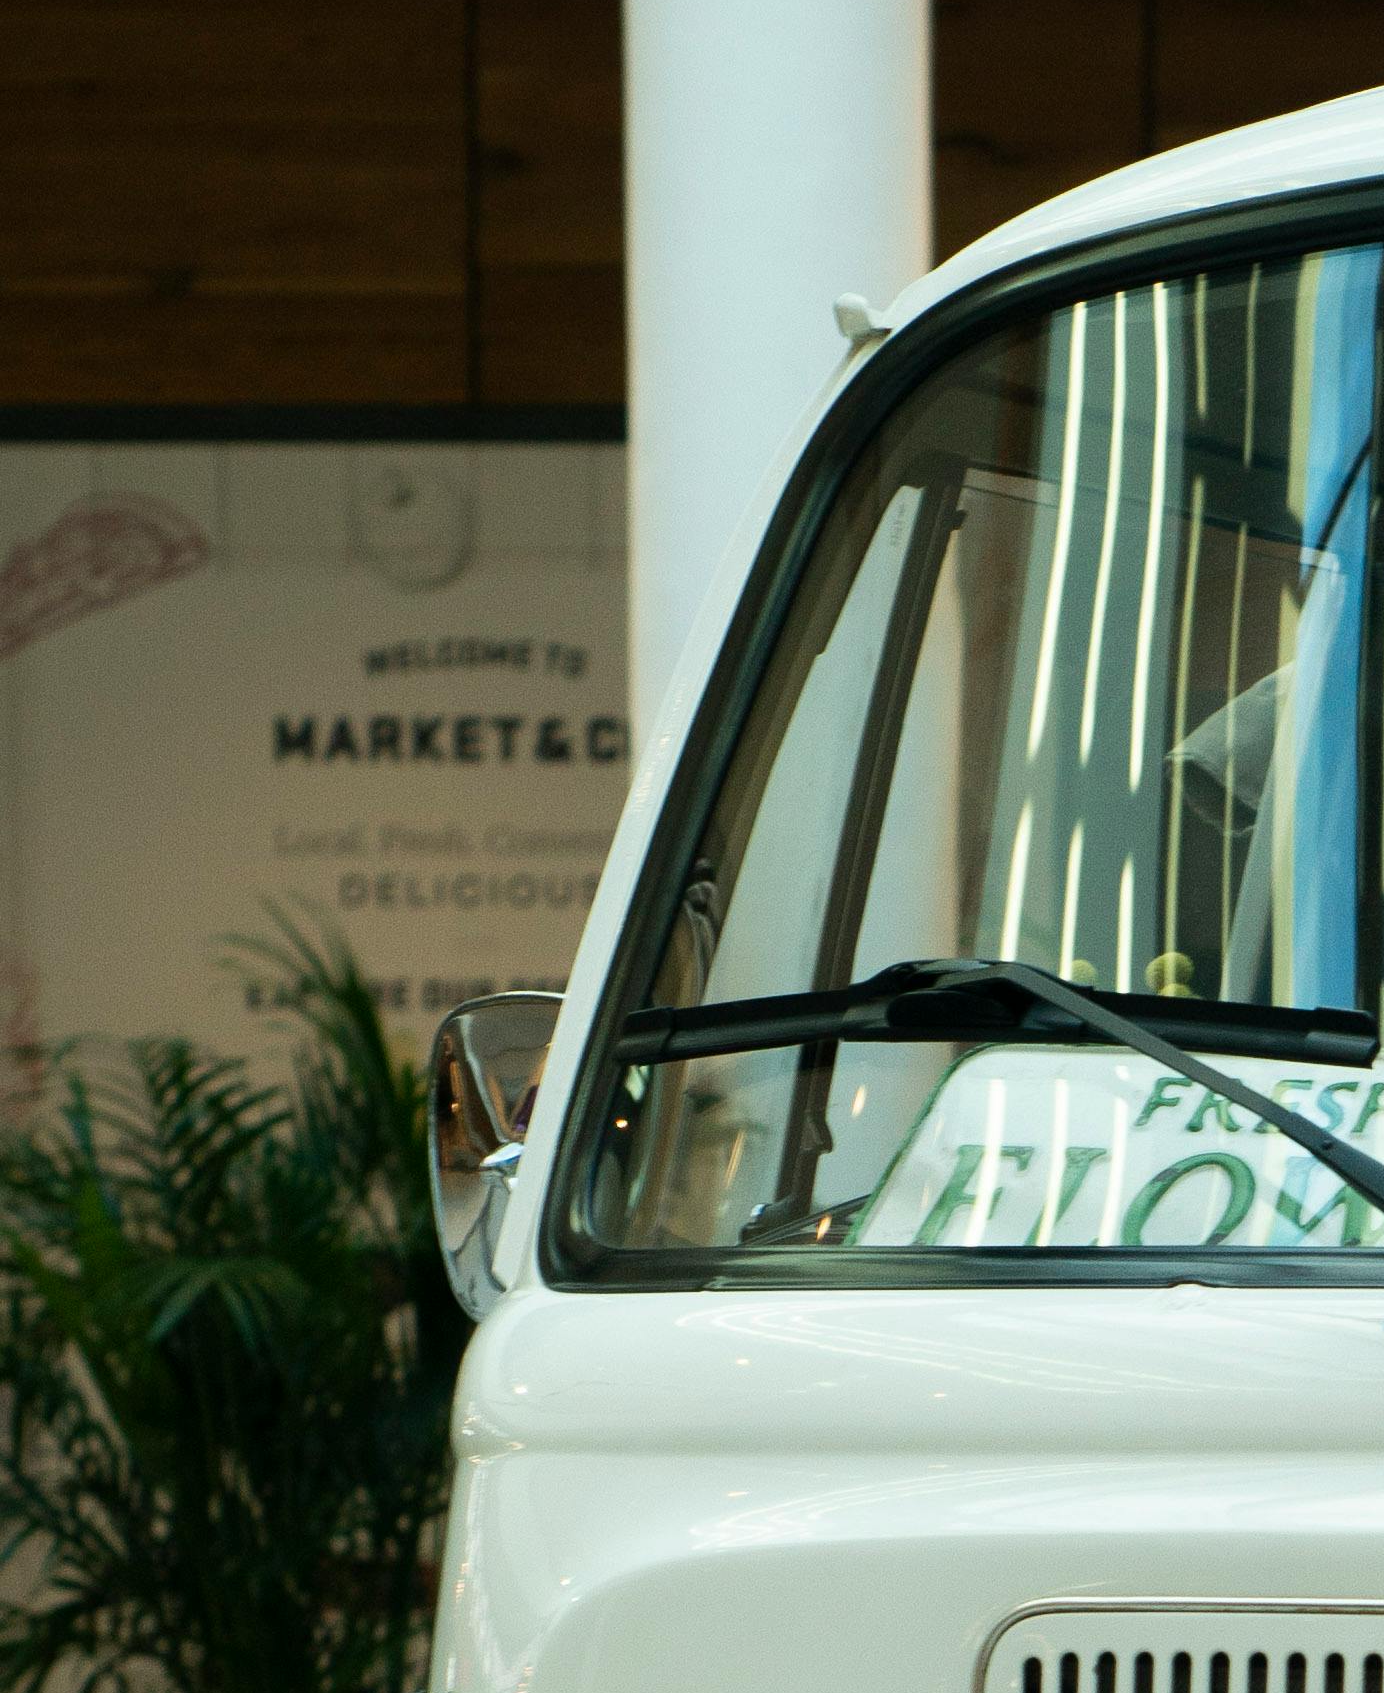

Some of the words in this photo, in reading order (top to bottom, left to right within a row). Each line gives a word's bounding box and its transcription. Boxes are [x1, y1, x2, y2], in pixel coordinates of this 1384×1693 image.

[364, 638, 530, 678] WELCOME
[546, 642, 588, 680] TO
[272, 714, 630, 763] MARKET&C
